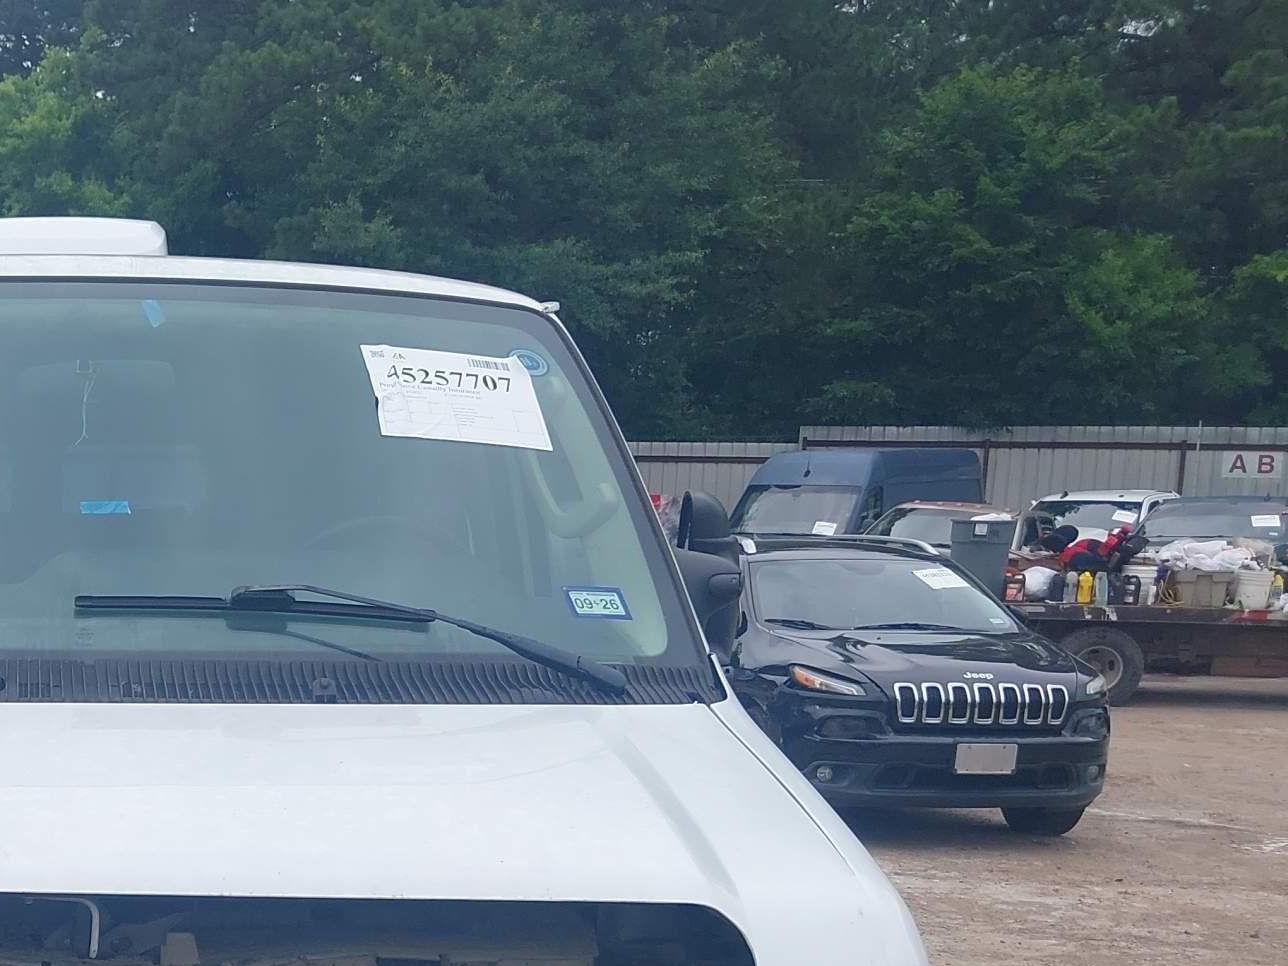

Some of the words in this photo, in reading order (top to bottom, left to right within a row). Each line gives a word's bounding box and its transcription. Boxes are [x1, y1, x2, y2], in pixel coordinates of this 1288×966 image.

[1229, 454, 1247, 473] A
[1257, 454, 1275, 473] B
[962, 671, 995, 680] Jeep
